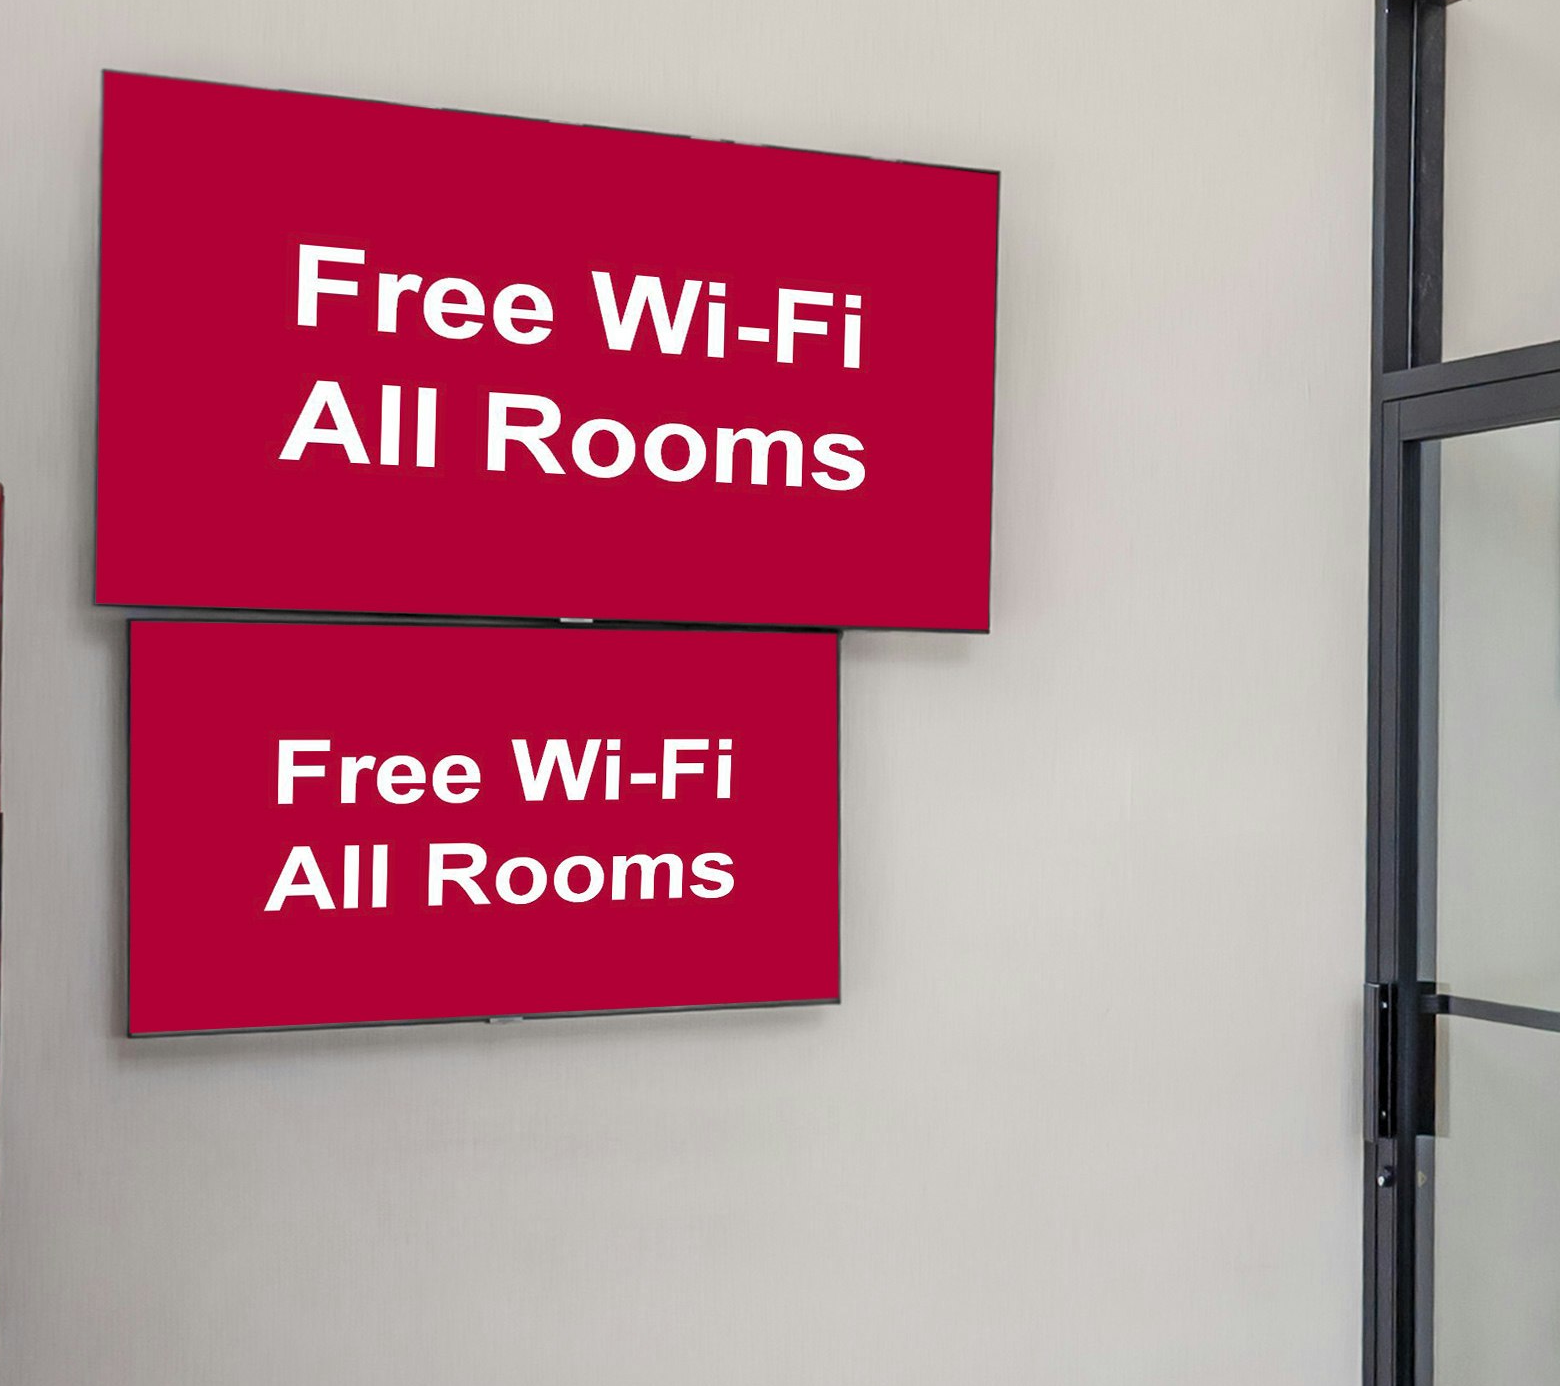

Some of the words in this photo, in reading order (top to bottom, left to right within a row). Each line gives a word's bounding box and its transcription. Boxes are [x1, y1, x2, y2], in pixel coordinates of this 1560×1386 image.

[298, 244, 553, 344] Free
[592, 271, 861, 368] Wi-Fi
[279, 381, 436, 467] All
[488, 392, 865, 490] Rooms
[278, 740, 480, 804] Free
[512, 739, 732, 801] Wi-Fi
[264, 845, 387, 911] All
[428, 843, 734, 906] Rooms
